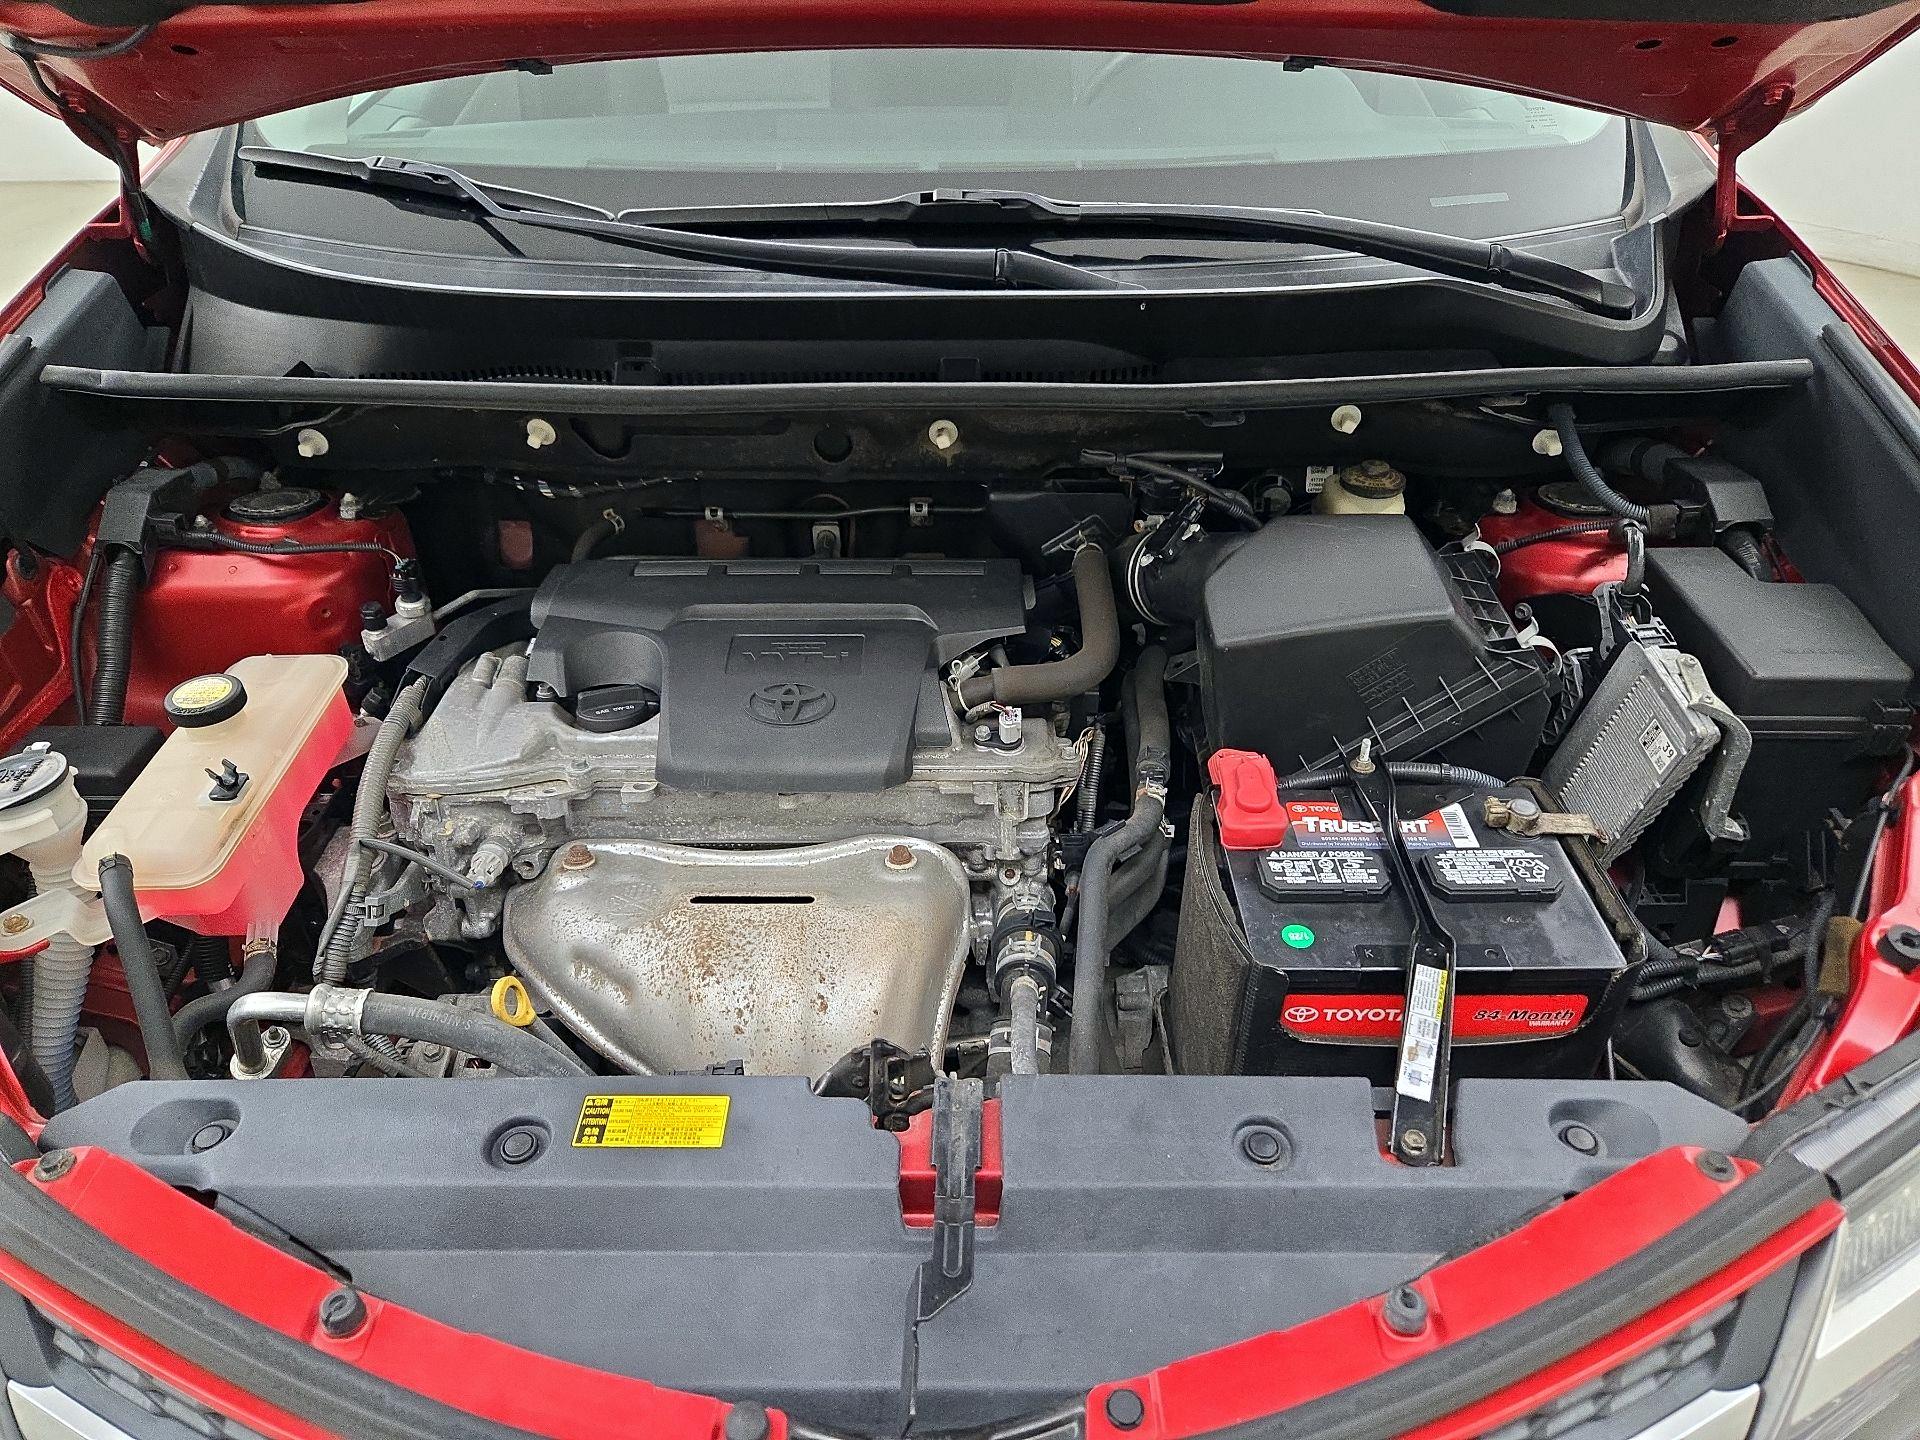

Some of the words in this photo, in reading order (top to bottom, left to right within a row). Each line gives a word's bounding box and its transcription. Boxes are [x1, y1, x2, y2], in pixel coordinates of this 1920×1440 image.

[1308, 804, 1341, 813] TOYO
[1528, 1019, 1570, 1027] WARRANTY
[584, 1107, 611, 1115] CAUTION
[581, 1117, 608, 1125] ATTENTION
